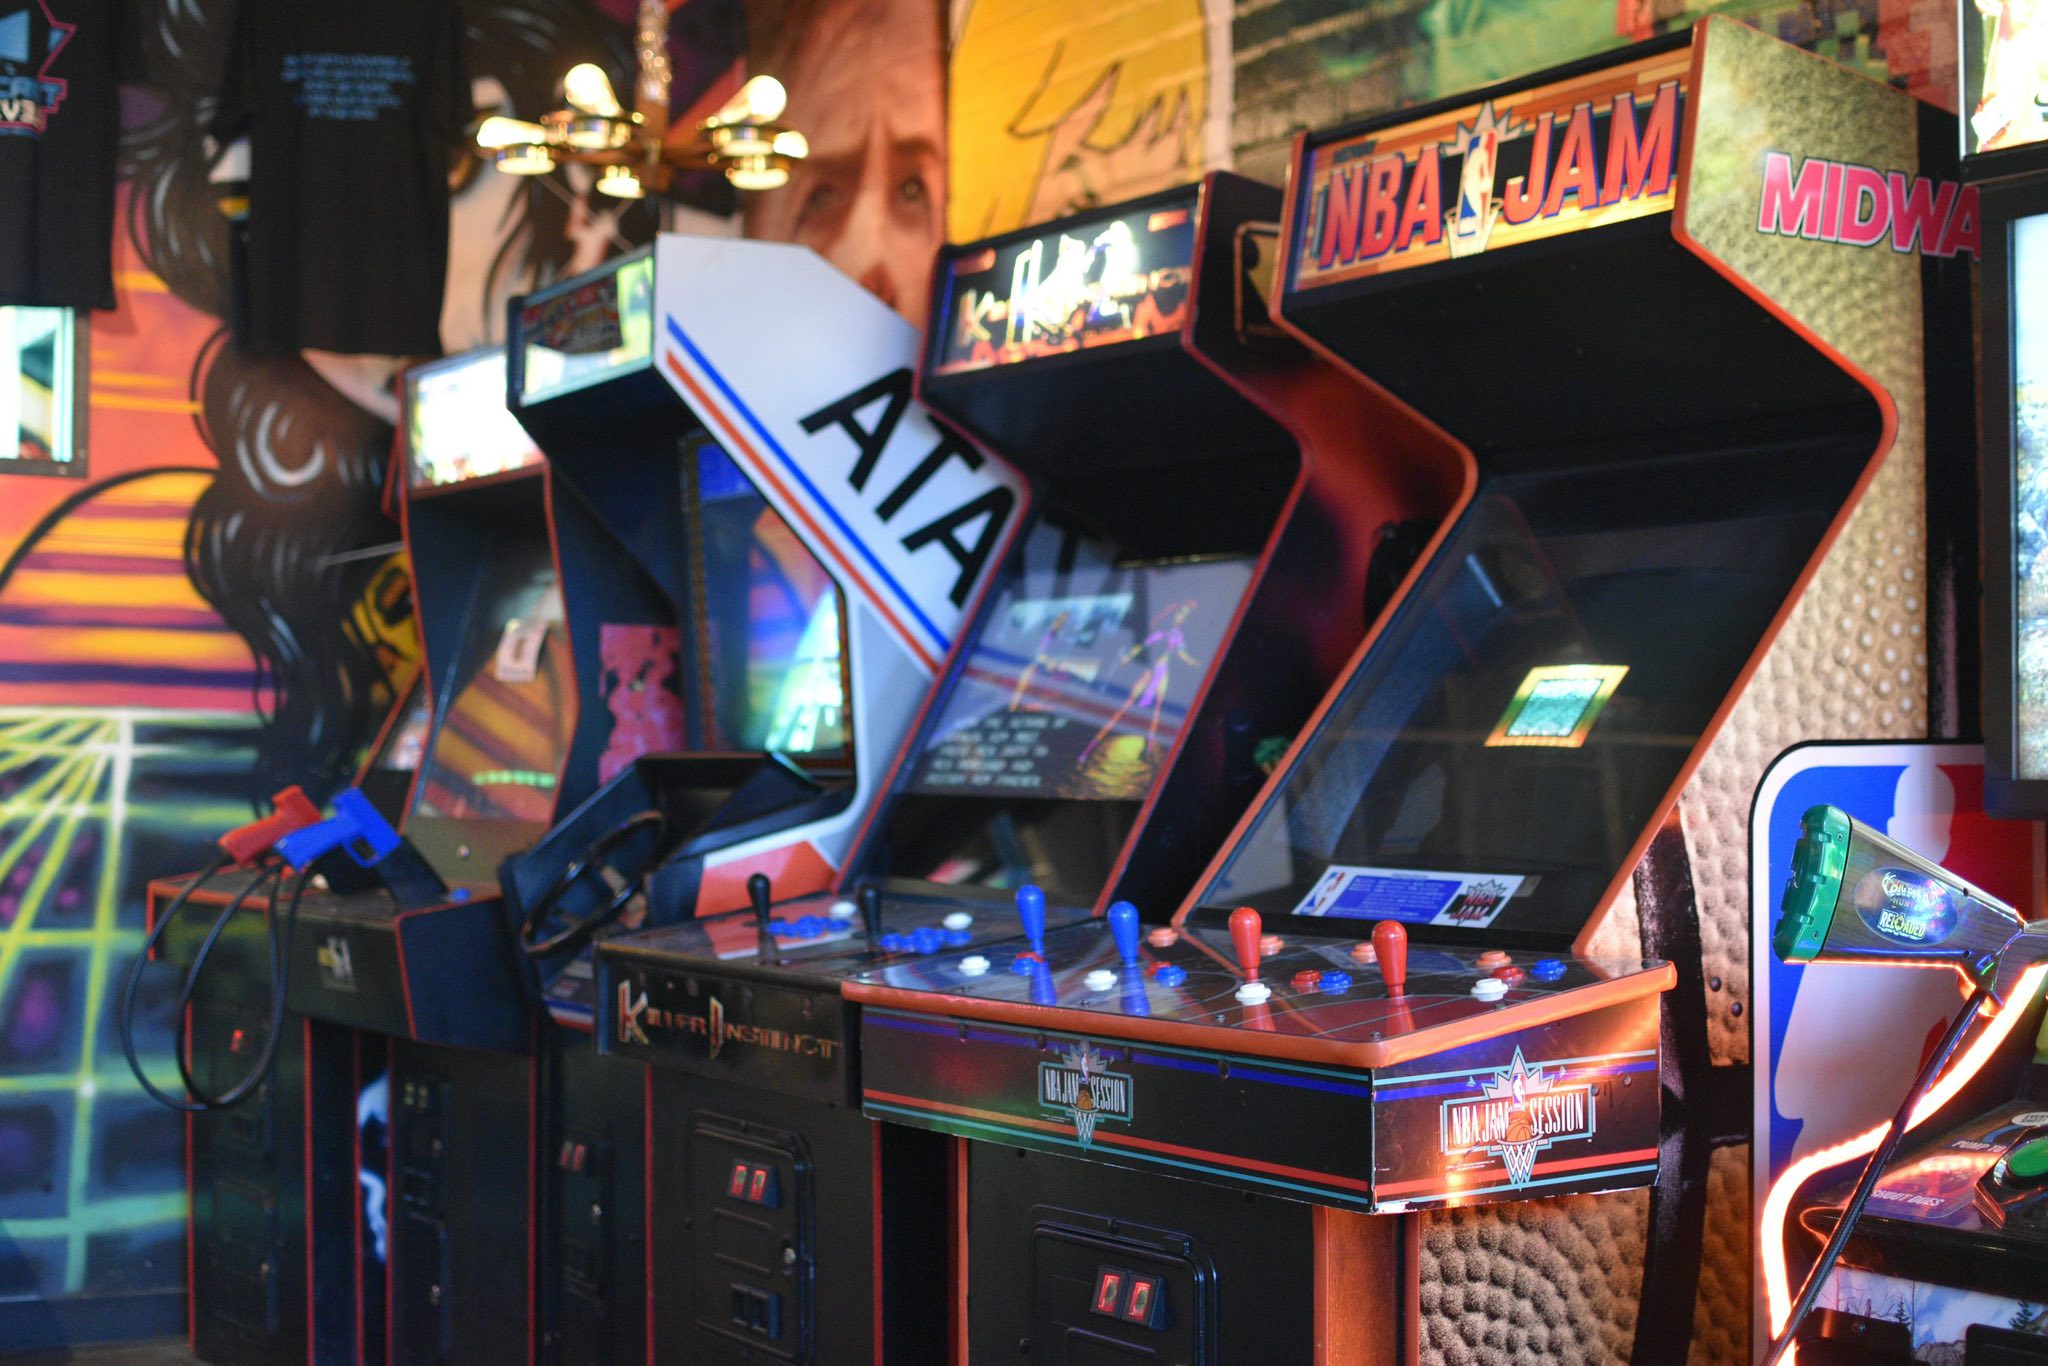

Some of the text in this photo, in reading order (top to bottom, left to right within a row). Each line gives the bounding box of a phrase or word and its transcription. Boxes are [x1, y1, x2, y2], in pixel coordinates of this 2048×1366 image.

[1317, 79, 1681, 270] NBA JAM
[1463, 889, 1497, 906] NBA
[1879, 911, 1927, 938] RELOADED
[1044, 1068, 1061, 1102] NBA
[1090, 1075, 1126, 1113] SESSION
[1452, 1092, 1585, 1145] NBA JAM SESSION
[1951, 1140, 1990, 1151] PUMP
